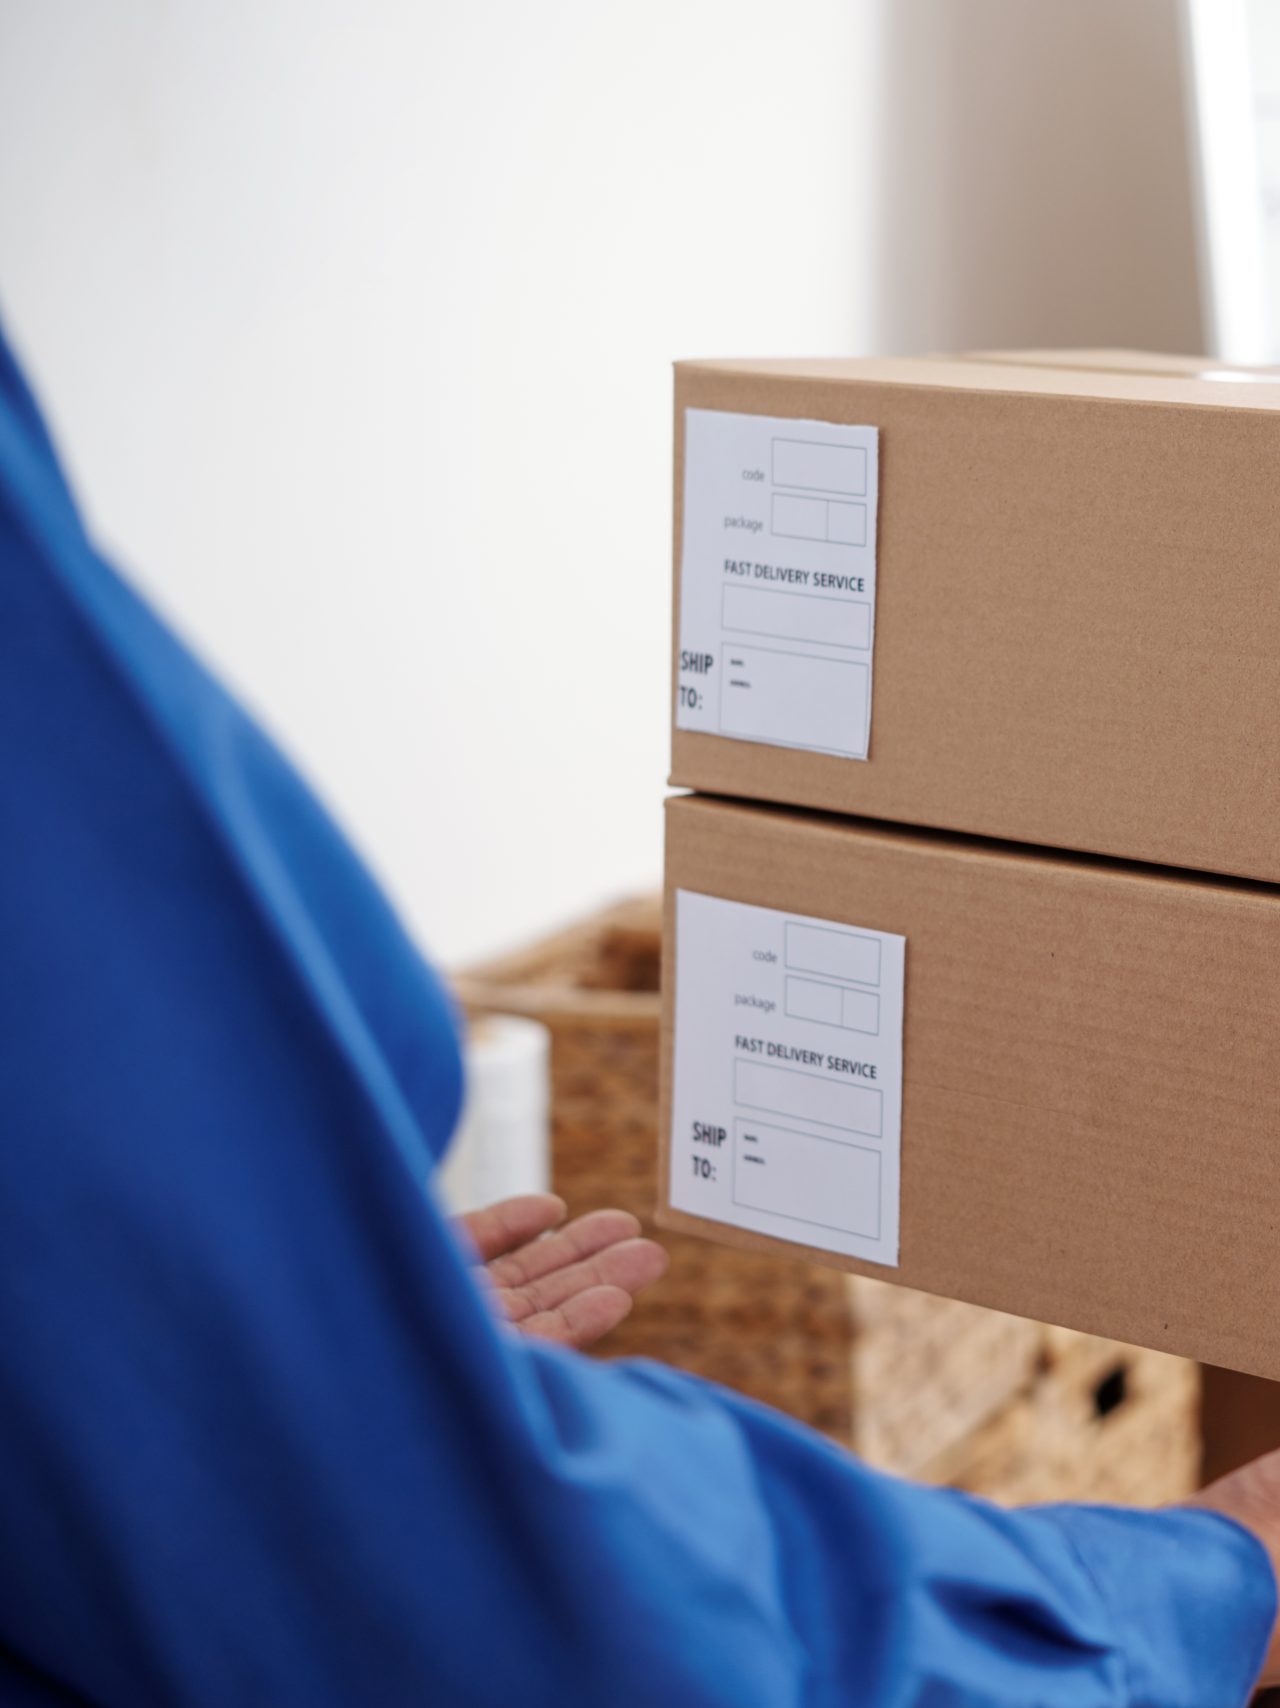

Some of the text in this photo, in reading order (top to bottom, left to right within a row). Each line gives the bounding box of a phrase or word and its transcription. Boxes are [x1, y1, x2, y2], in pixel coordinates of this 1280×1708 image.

[742, 468, 765, 482] code
[724, 514, 764, 533] package
[724, 560, 865, 592] FAST DELIVERY SERVICE
[681, 651, 714, 675] SHIP
[680, 685, 703, 710] TO:
[753, 949, 777, 964] code
[735, 994, 776, 1013] package
[735, 1035, 877, 1079] FAST DELIVERY SERVICE
[693, 1121, 727, 1148] SHIP
[692, 1155, 716, 1182] TO:
